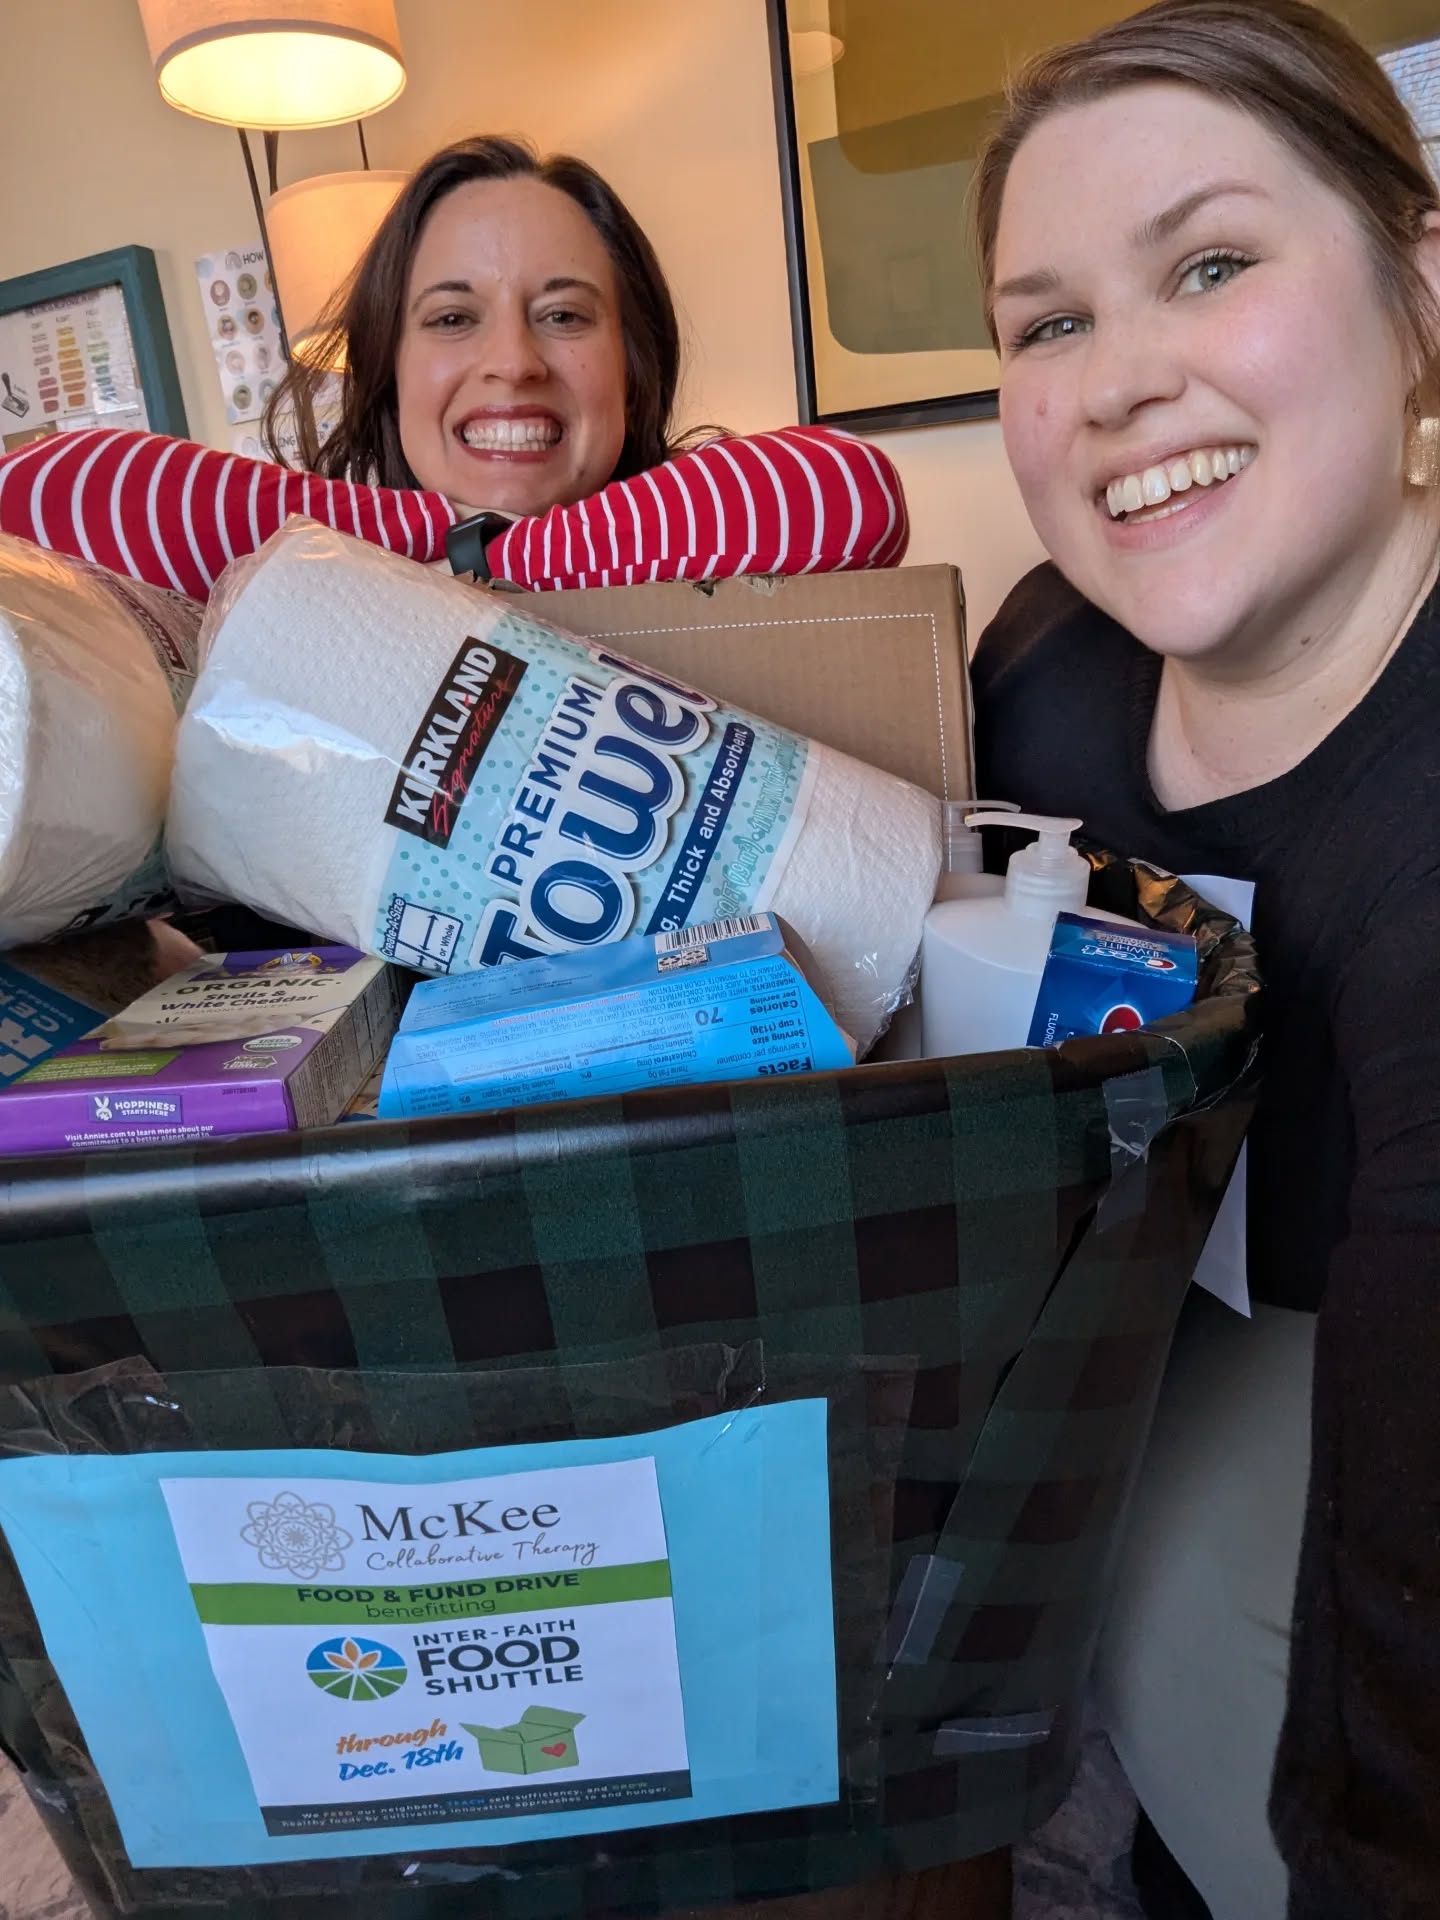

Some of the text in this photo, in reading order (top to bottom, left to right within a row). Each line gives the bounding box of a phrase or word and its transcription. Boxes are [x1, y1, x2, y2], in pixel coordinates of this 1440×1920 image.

[243, 252, 264, 264] HOW
[396, 647, 498, 825] KIRKLAND
[431, 664, 515, 837] Signature
[491, 681, 602, 886] PREMIUM
[480, 653, 707, 967] Towel
[667, 727, 749, 906] Thick and Absorbent
[438, 923, 454, 956] or Whole
[1081, 945, 1176, 970] Crest
[176, 977, 331, 996] ORGANIC
[204, 990, 286, 1001] Shells &
[749, 990, 796, 1005] per serving
[161, 994, 318, 1011] White Cheddar
[693, 998, 798, 1027] Calories 70
[749, 1017, 802, 1035] 1 cup (113g)
[751, 1027, 805, 1045] Serving size
[716, 1051, 751, 1064] container
[753, 1047, 766, 1056] per
[767, 1041, 799, 1054] servings
[756, 1056, 812, 1079] Facts
[115, 1101, 176, 1113] HOPPINESS
[149, 1108, 169, 1116] HERE
[84, 1131, 127, 1140] Annies.com
[136, 1128, 156, 1136] learn
[355, 1499, 561, 1541] McKee
[367, 1532, 600, 1571] Collaborative Therapy
[297, 1573, 580, 1603] FOOD & FUND DRIVE
[365, 1599, 496, 1618] benefitting
[412, 1619, 576, 1647] INTER-FAITH
[417, 1636, 580, 1676] FOOD
[425, 1665, 584, 1696] SHUTTLE
[336, 1718, 448, 1755] through
[338, 1740, 465, 1781] Dec. 18th
[381, 1803, 443, 1814] neighbors,
[489, 1789, 583, 1804] self-sufficiency,
[587, 1785, 608, 1793] and
[626, 1786, 671, 1797] hunger.
